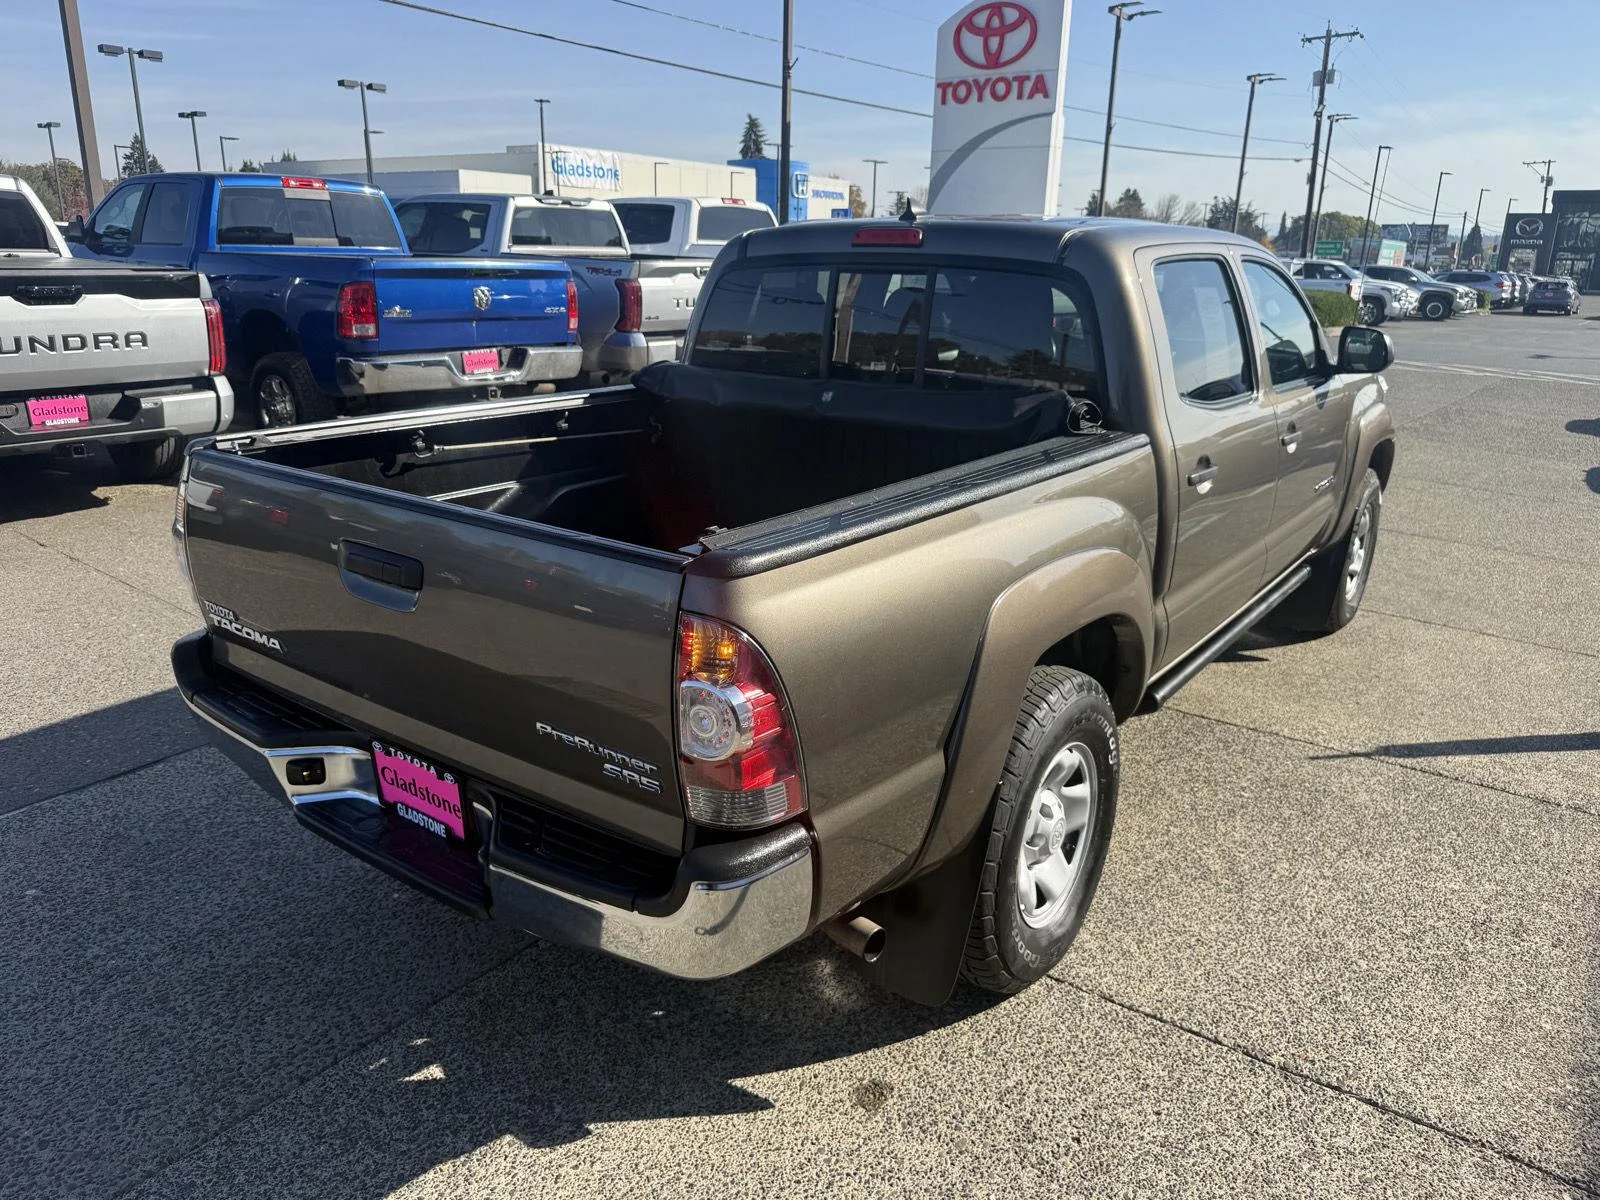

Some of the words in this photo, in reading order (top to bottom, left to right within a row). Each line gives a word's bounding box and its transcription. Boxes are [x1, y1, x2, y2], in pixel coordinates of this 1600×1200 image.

[936, 73, 1049, 106] TOYOTA
[551, 155, 620, 182] Gladstone
[32, 406, 87, 417] Gladstone
[45, 417, 80, 426] GLADSTONE
[204, 600, 235, 622] TOYOTA
[209, 613, 284, 653] TACOMA
[389, 747, 438, 778] TOYOTA
[536, 721, 658, 774] PreRunner
[381, 765, 462, 819] Gladstone
[602, 763, 661, 794] SR5
[396, 802, 447, 839] GLADSTONE
